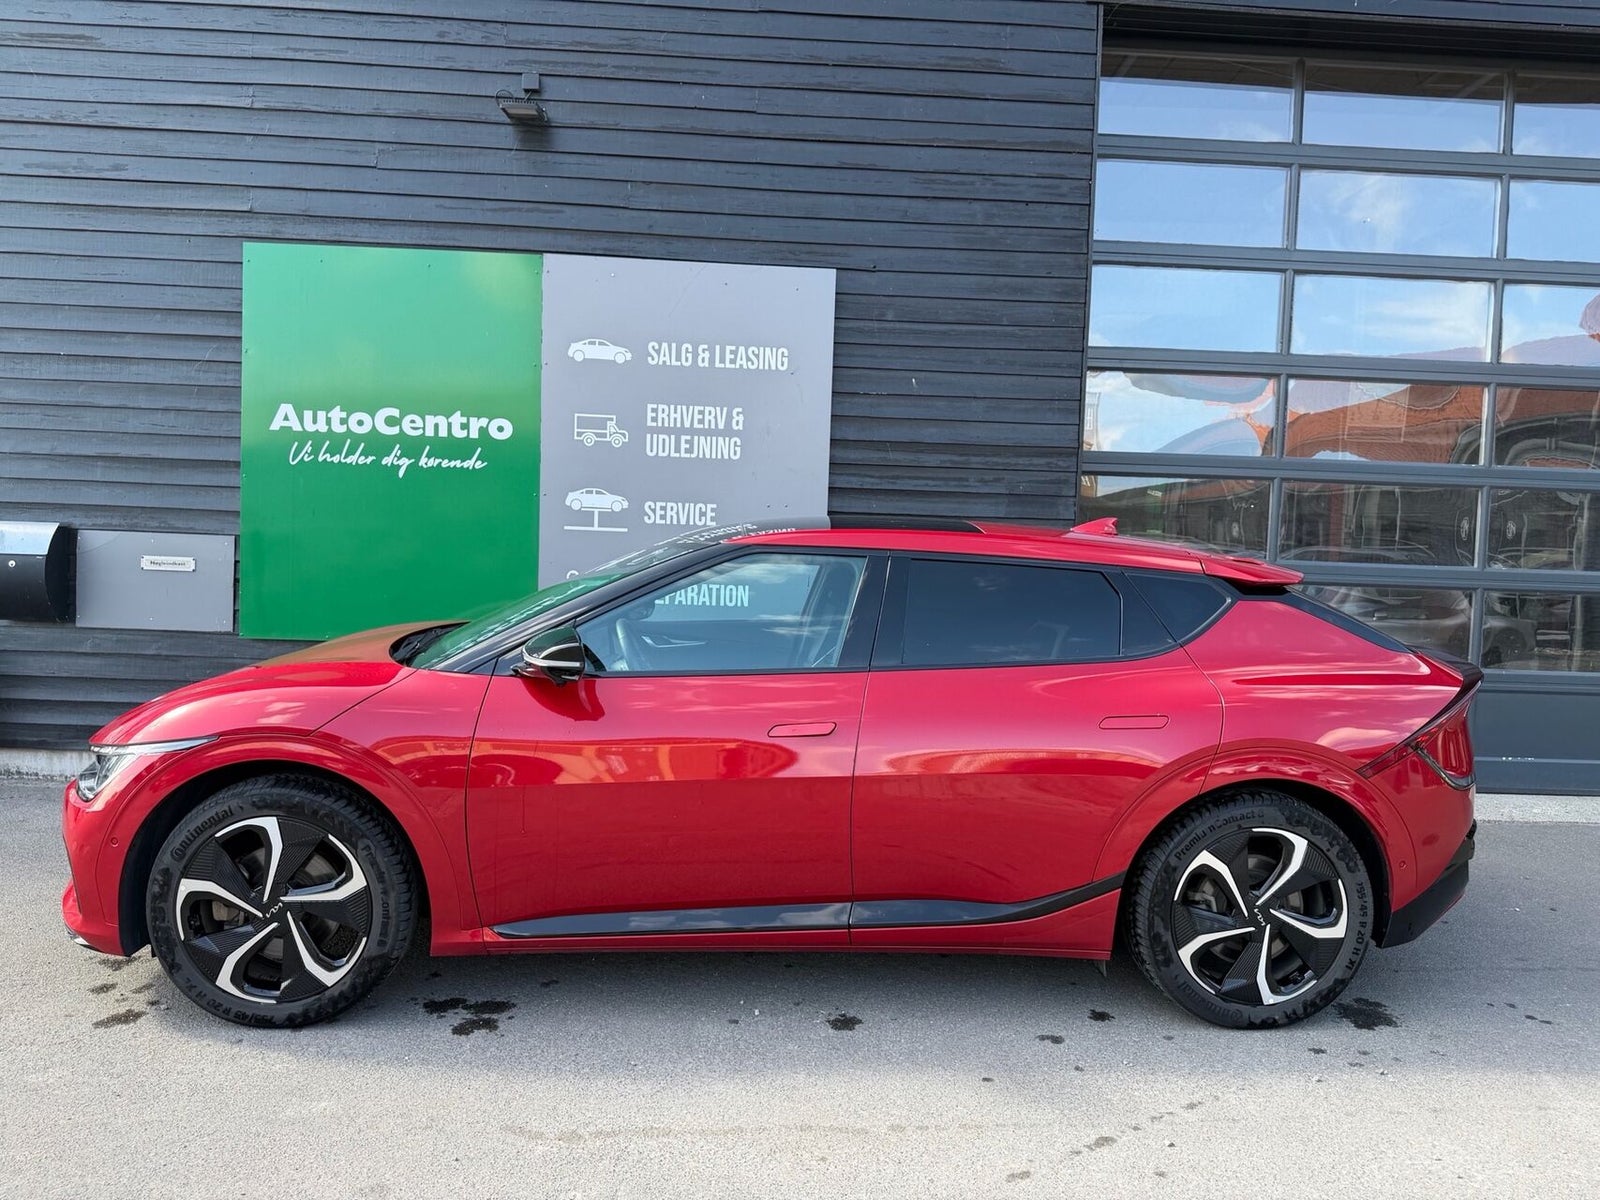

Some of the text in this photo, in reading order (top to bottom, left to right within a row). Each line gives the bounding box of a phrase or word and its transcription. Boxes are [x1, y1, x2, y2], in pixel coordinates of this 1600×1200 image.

[647, 341, 789, 371] SALG & LEASING
[269, 403, 514, 440] AutoCentro
[646, 403, 744, 431] ERHVERV &
[288, 440, 314, 466] Vi
[318, 438, 376, 465] holder
[381, 444, 416, 478] dig
[646, 433, 741, 460] UDLEJNING
[643, 501, 717, 526] SERVICE
[655, 583, 749, 607] PARATION
[170, 805, 234, 862] Continental
